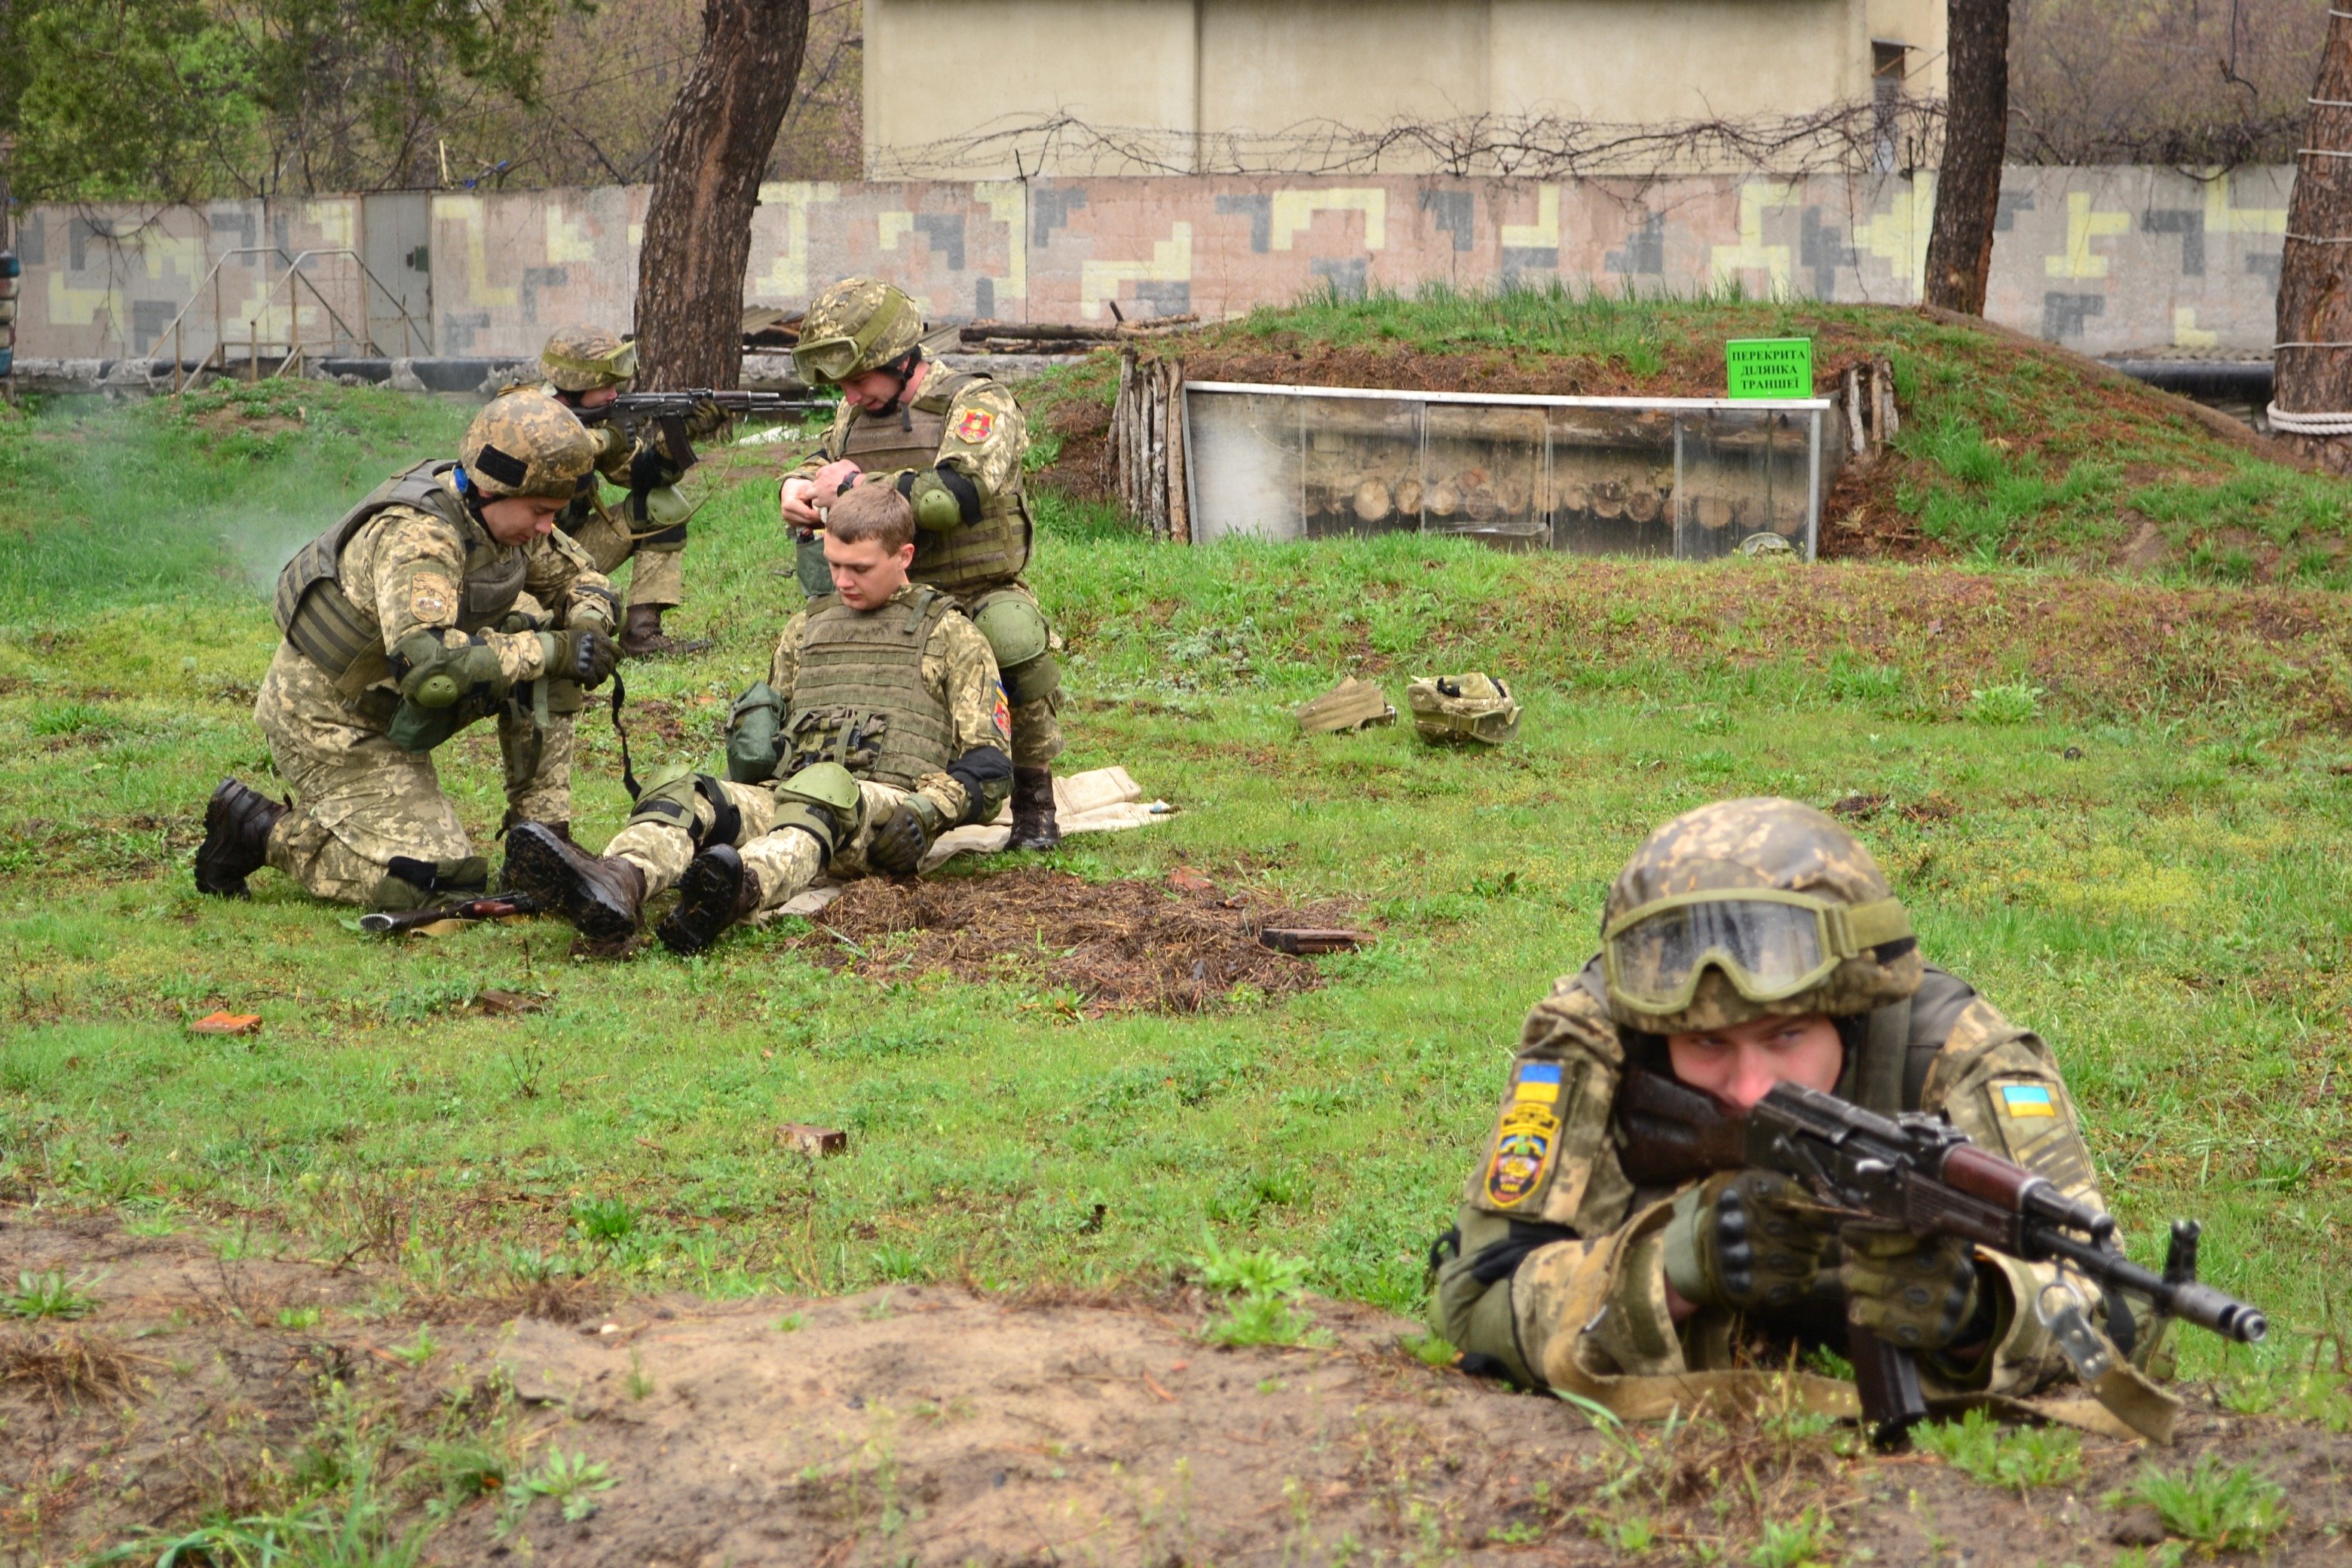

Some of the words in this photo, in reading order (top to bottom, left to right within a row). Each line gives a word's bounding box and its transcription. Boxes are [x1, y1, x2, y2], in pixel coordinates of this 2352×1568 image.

[1732, 350, 1805, 361] ПЕРЕКРИТА
[1741, 366, 1797, 376] ДІЛЯНКА
[1741, 377, 1799, 390] ТРАНШЕЇ
